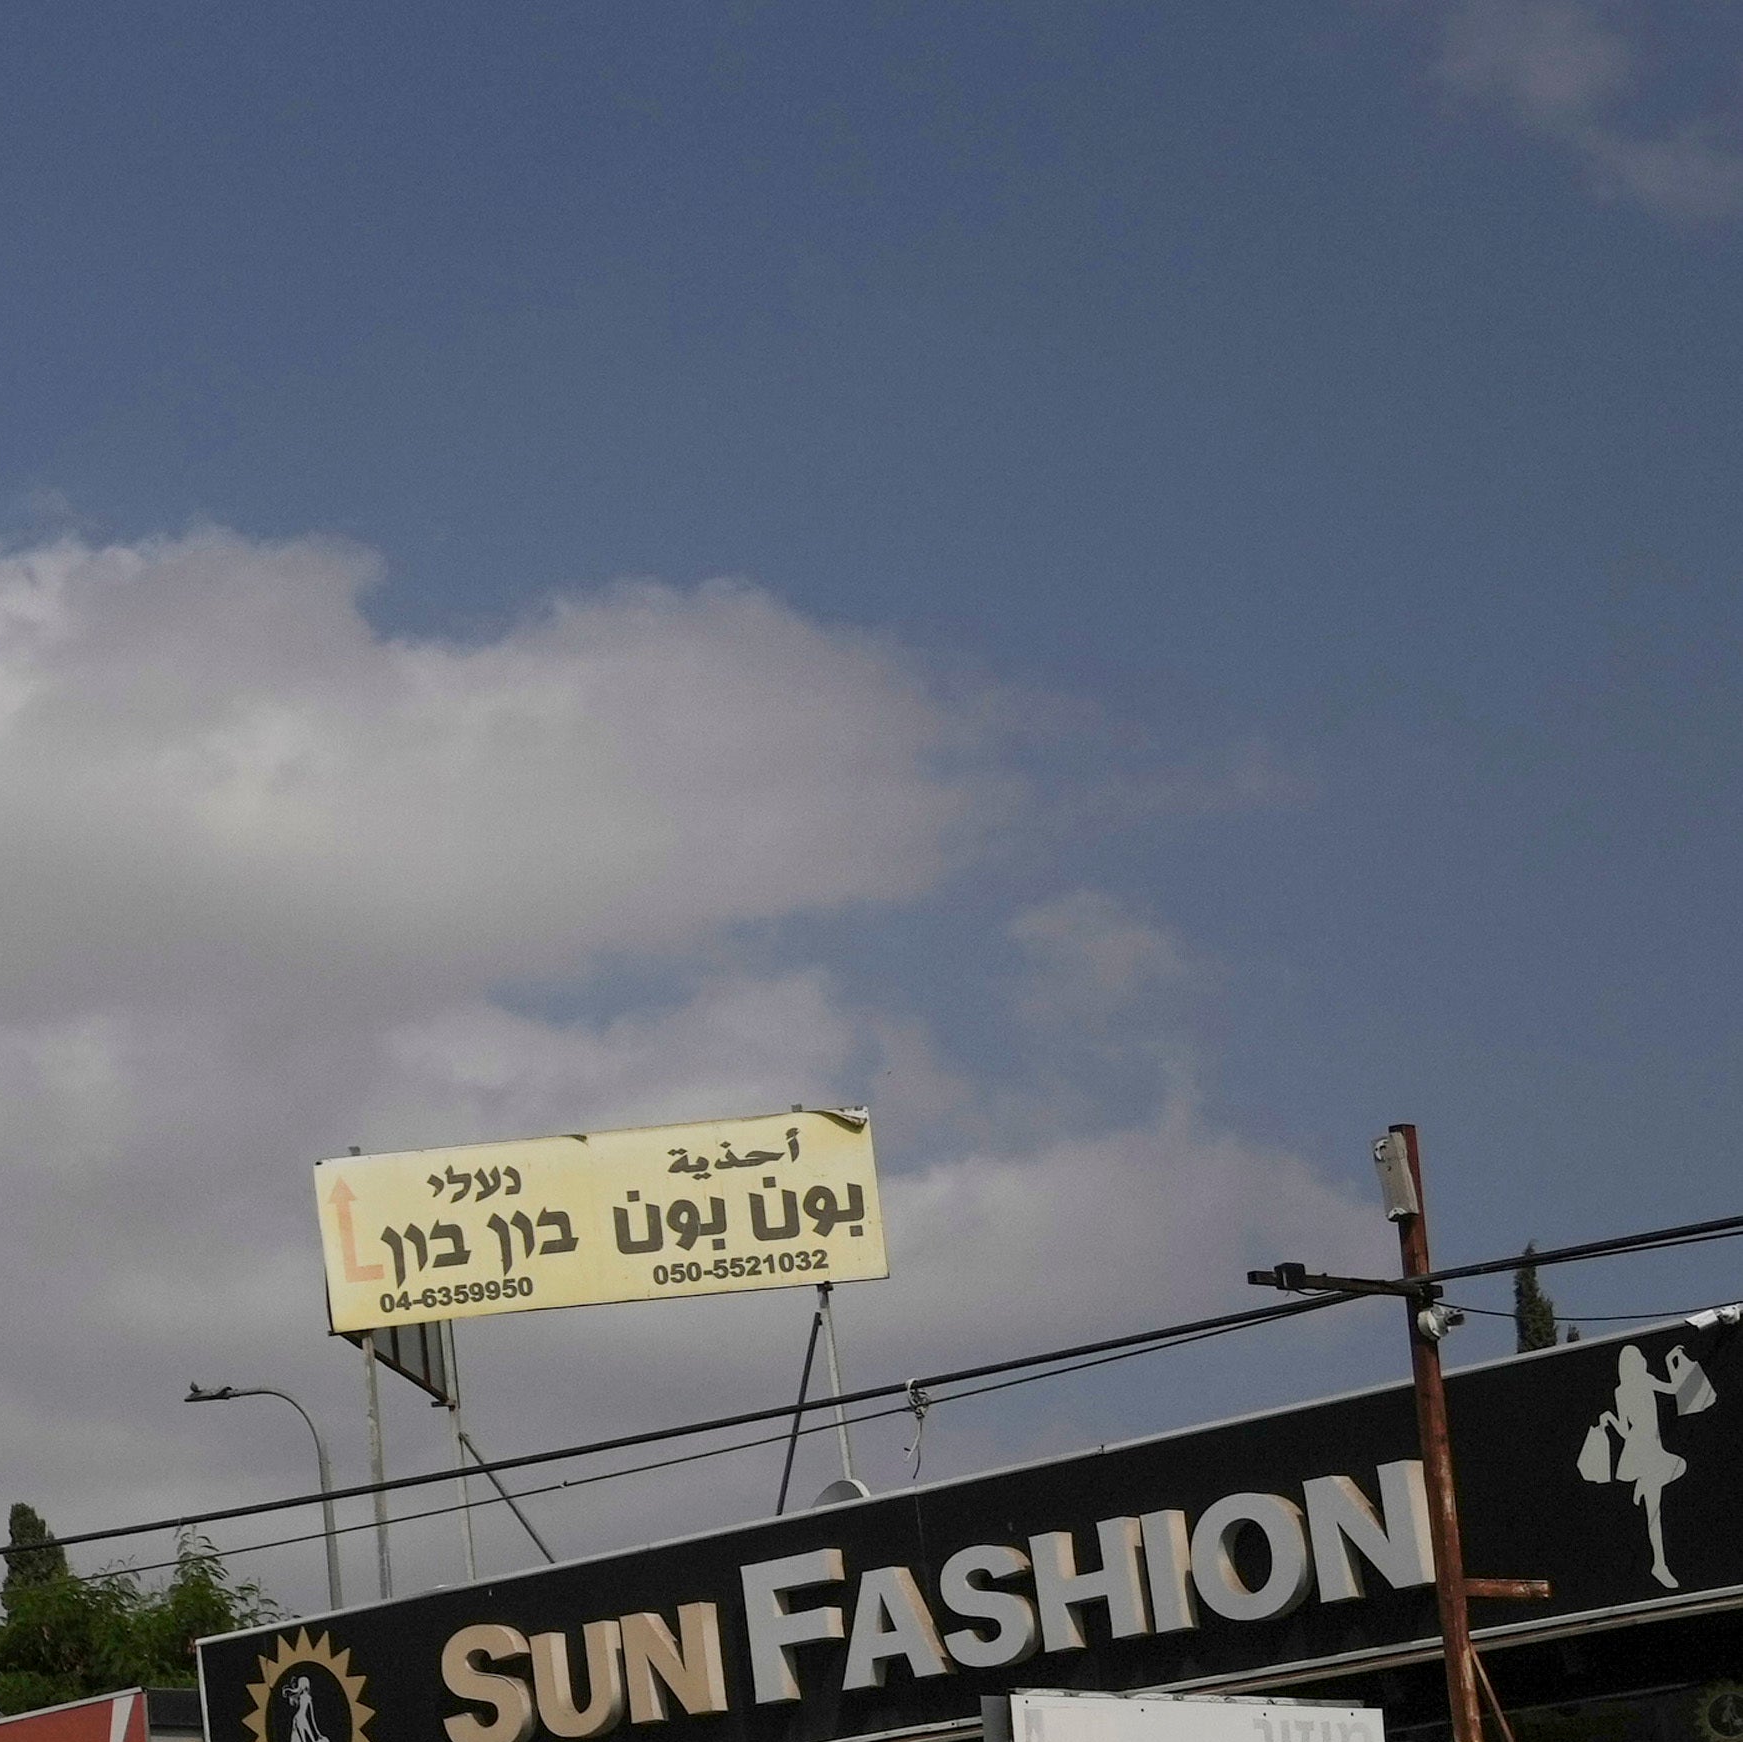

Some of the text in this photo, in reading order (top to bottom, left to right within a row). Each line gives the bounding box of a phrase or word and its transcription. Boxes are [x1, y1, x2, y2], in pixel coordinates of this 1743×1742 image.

[668, 1128, 800, 1180] أحذية
[428, 1165, 522, 1204] נעלי
[613, 1176, 865, 1254] بون بون
[381, 1207, 579, 1289] בון בון
[652, 1248, 829, 1286] 050-5521032
[380, 1276, 534, 1314] 04-6359950
[741, 1459, 1438, 1705] FASHION
